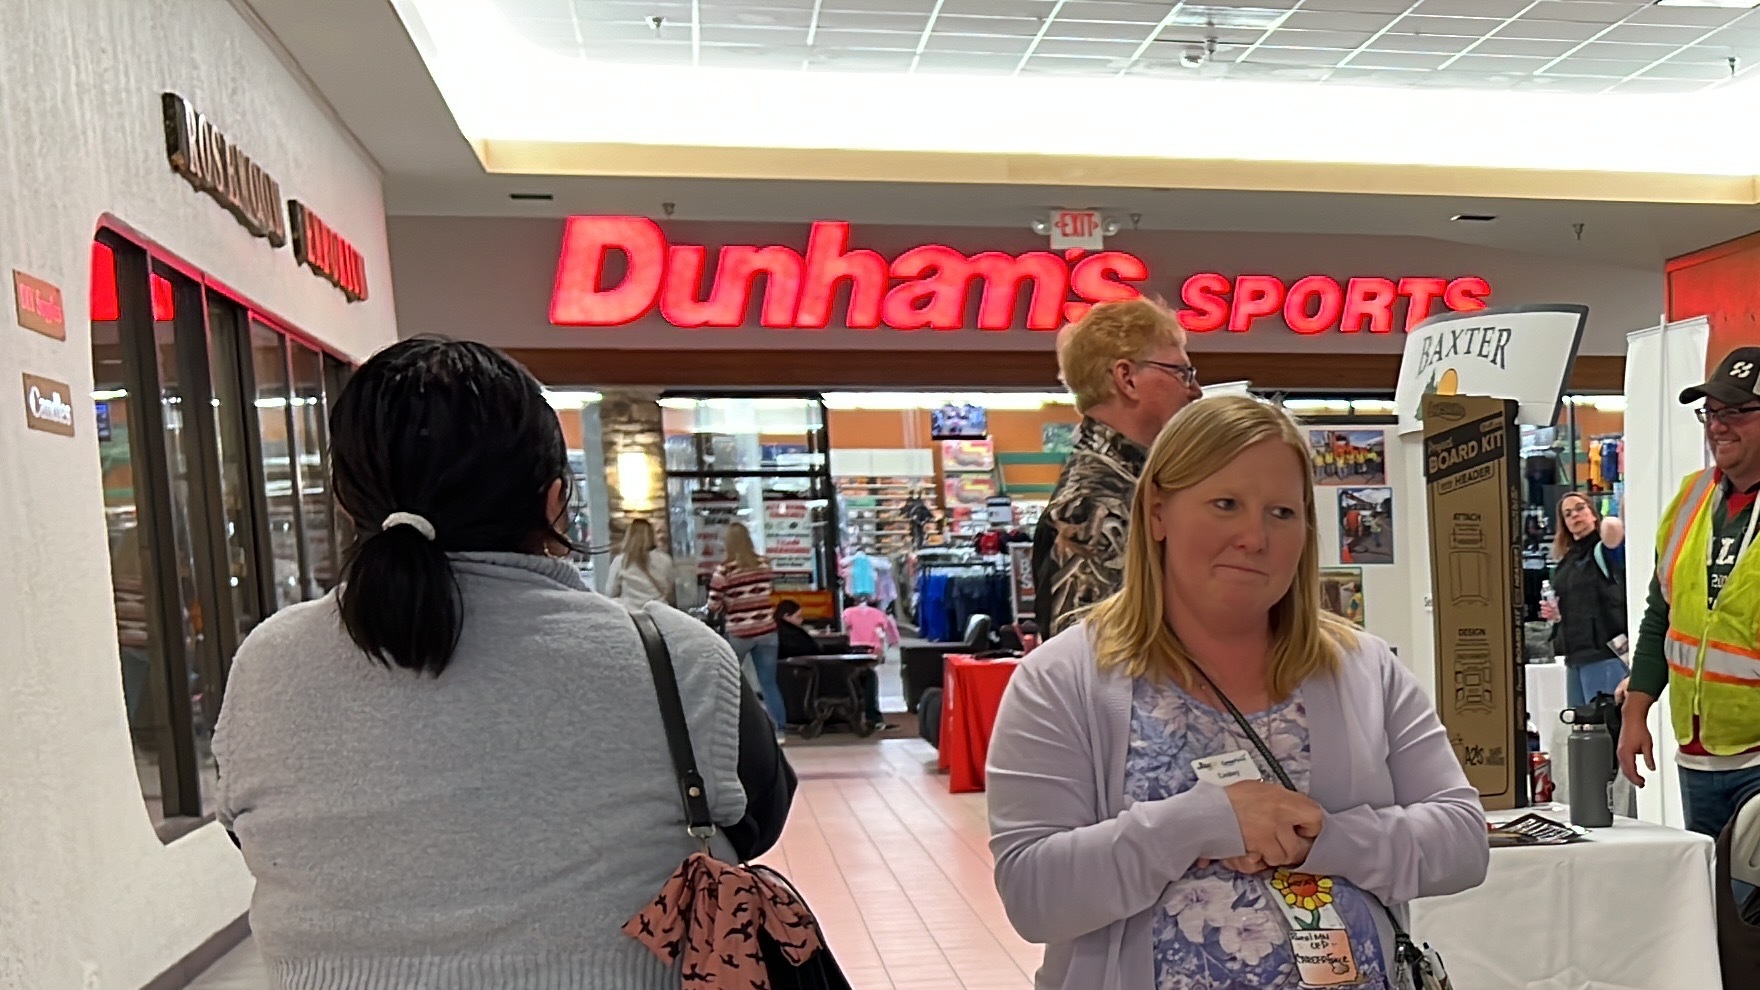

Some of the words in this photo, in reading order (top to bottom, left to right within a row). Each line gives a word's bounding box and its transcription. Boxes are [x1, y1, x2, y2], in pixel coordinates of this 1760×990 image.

[1062, 212, 1095, 237] EXIT
[549, 214, 1148, 330] Dunham's
[1176, 272, 1492, 335] SPORTS
[1417, 326, 1512, 376] BAXTER
[1428, 440, 1478, 474] BOARD
[1481, 430, 1504, 453] KIT
[1454, 465, 1491, 485] HEADER
[1453, 512, 1482, 522] ATTACH
[1458, 628, 1486, 637] DESIGN
